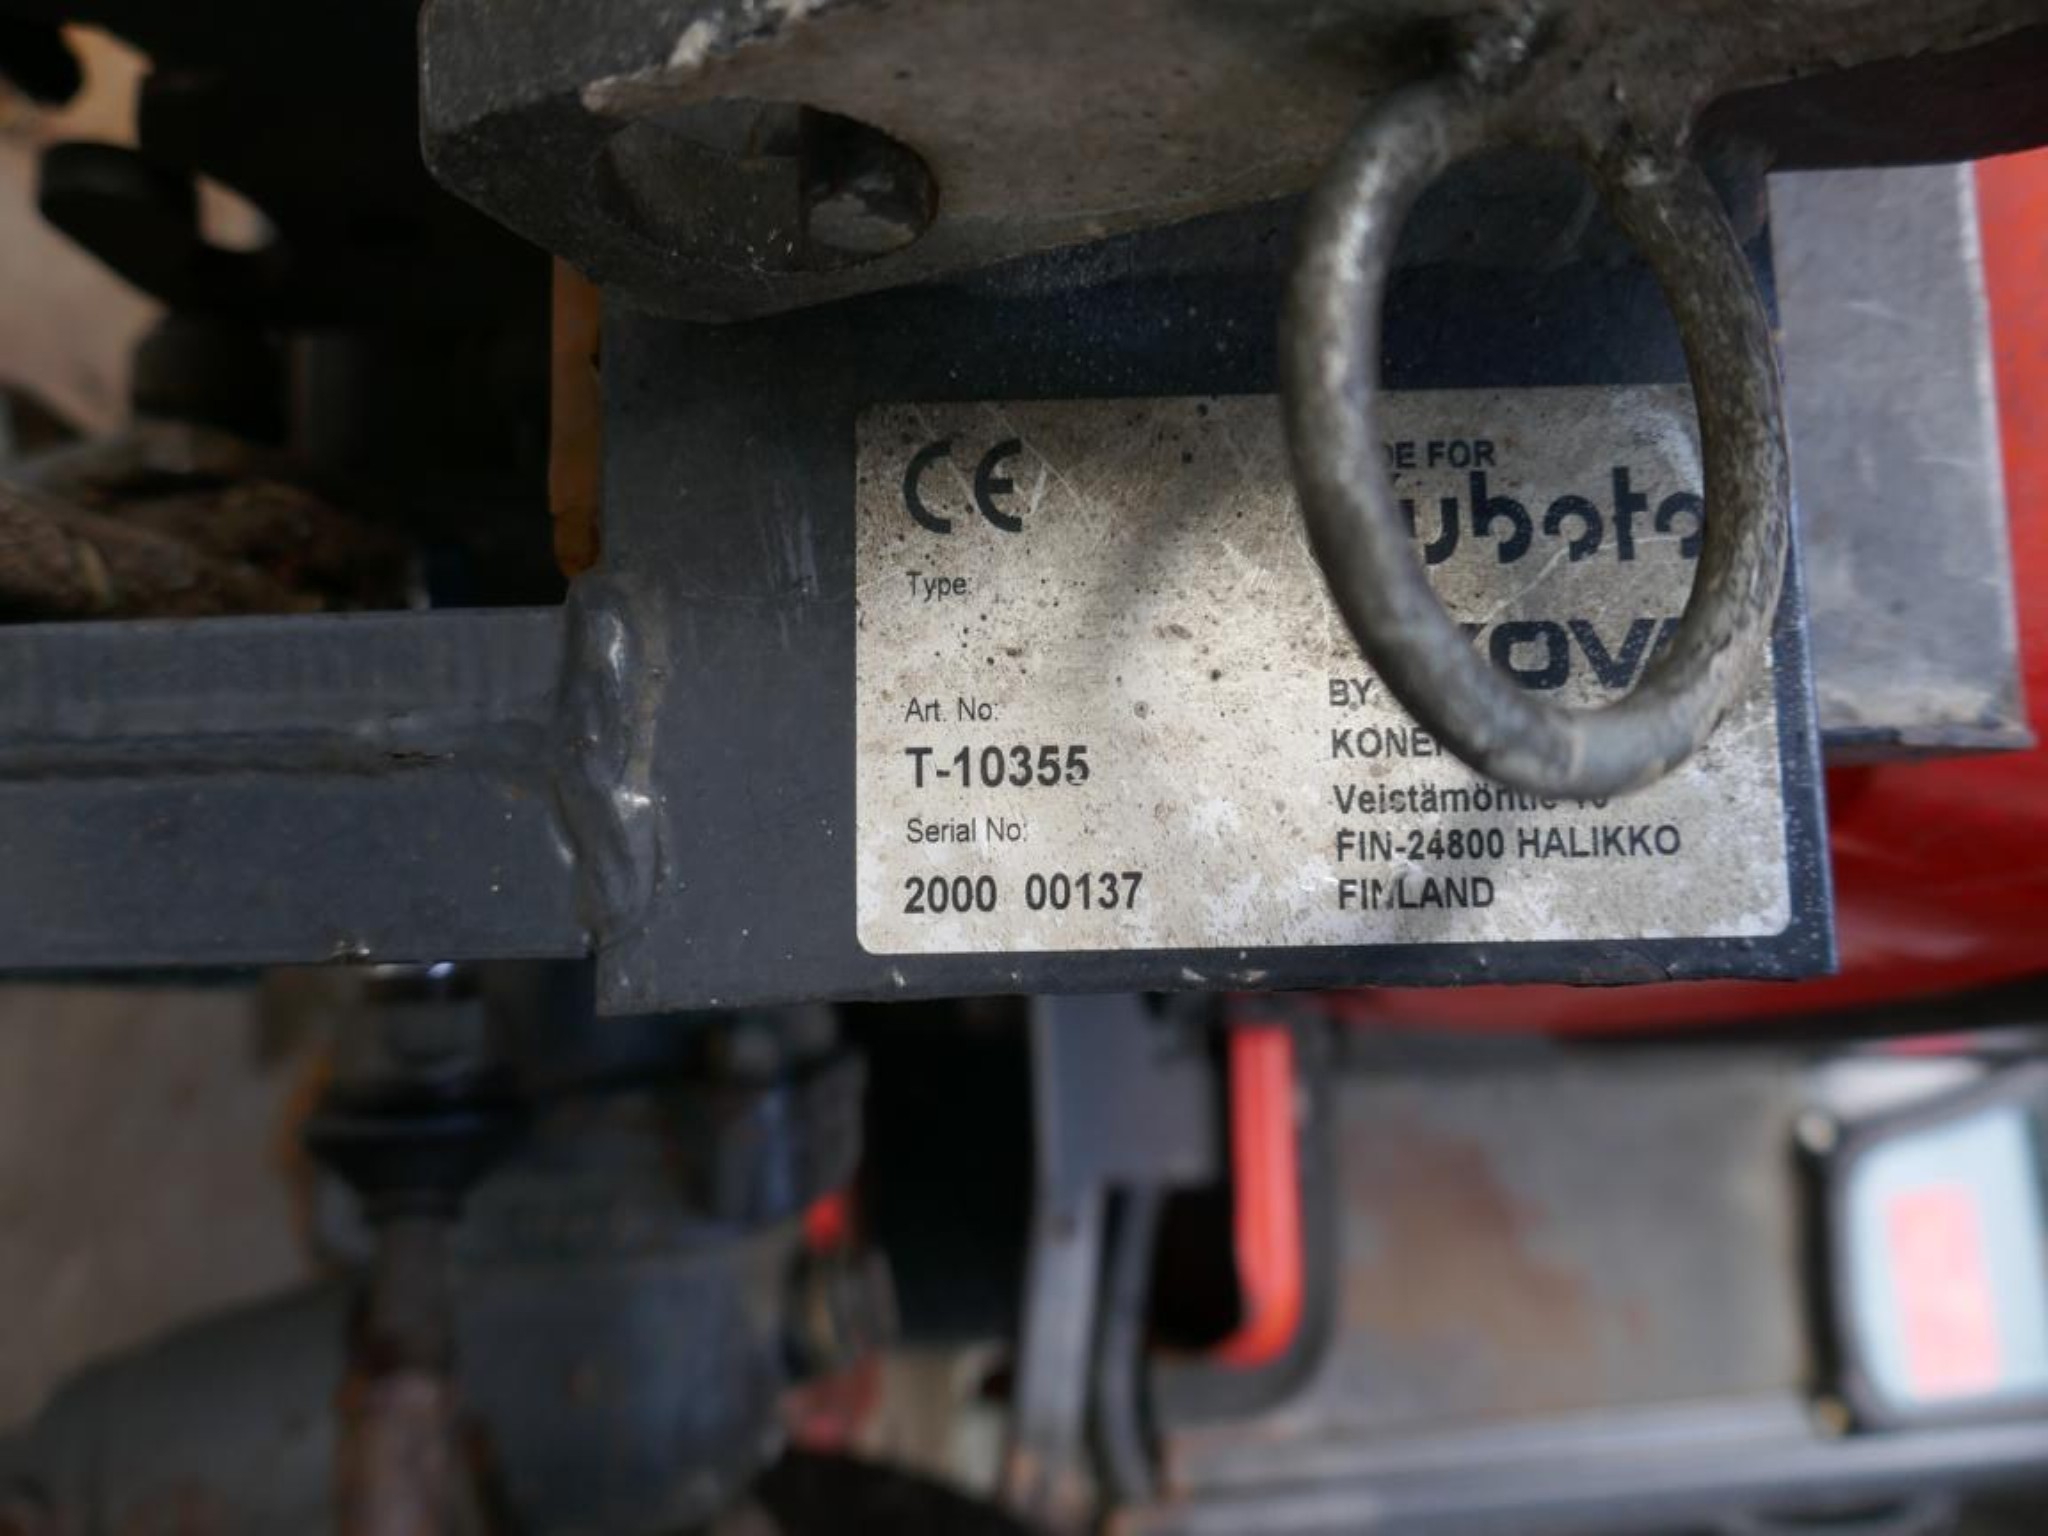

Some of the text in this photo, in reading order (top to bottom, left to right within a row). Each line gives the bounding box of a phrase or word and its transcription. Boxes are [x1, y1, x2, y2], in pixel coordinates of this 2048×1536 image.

[1427, 440, 1495, 468] FOR
[1391, 466, 1705, 564] ubota
[1328, 678, 1374, 706] BY
[904, 697, 999, 723] Art. No:
[1330, 727, 1442, 759] KONE
[904, 745, 1090, 788] T-10355
[906, 818, 1027, 844] Serial No:
[1336, 825, 1681, 863] FIN-24800 HALIKKO
[904, 871, 1143, 914] 2000 00137
